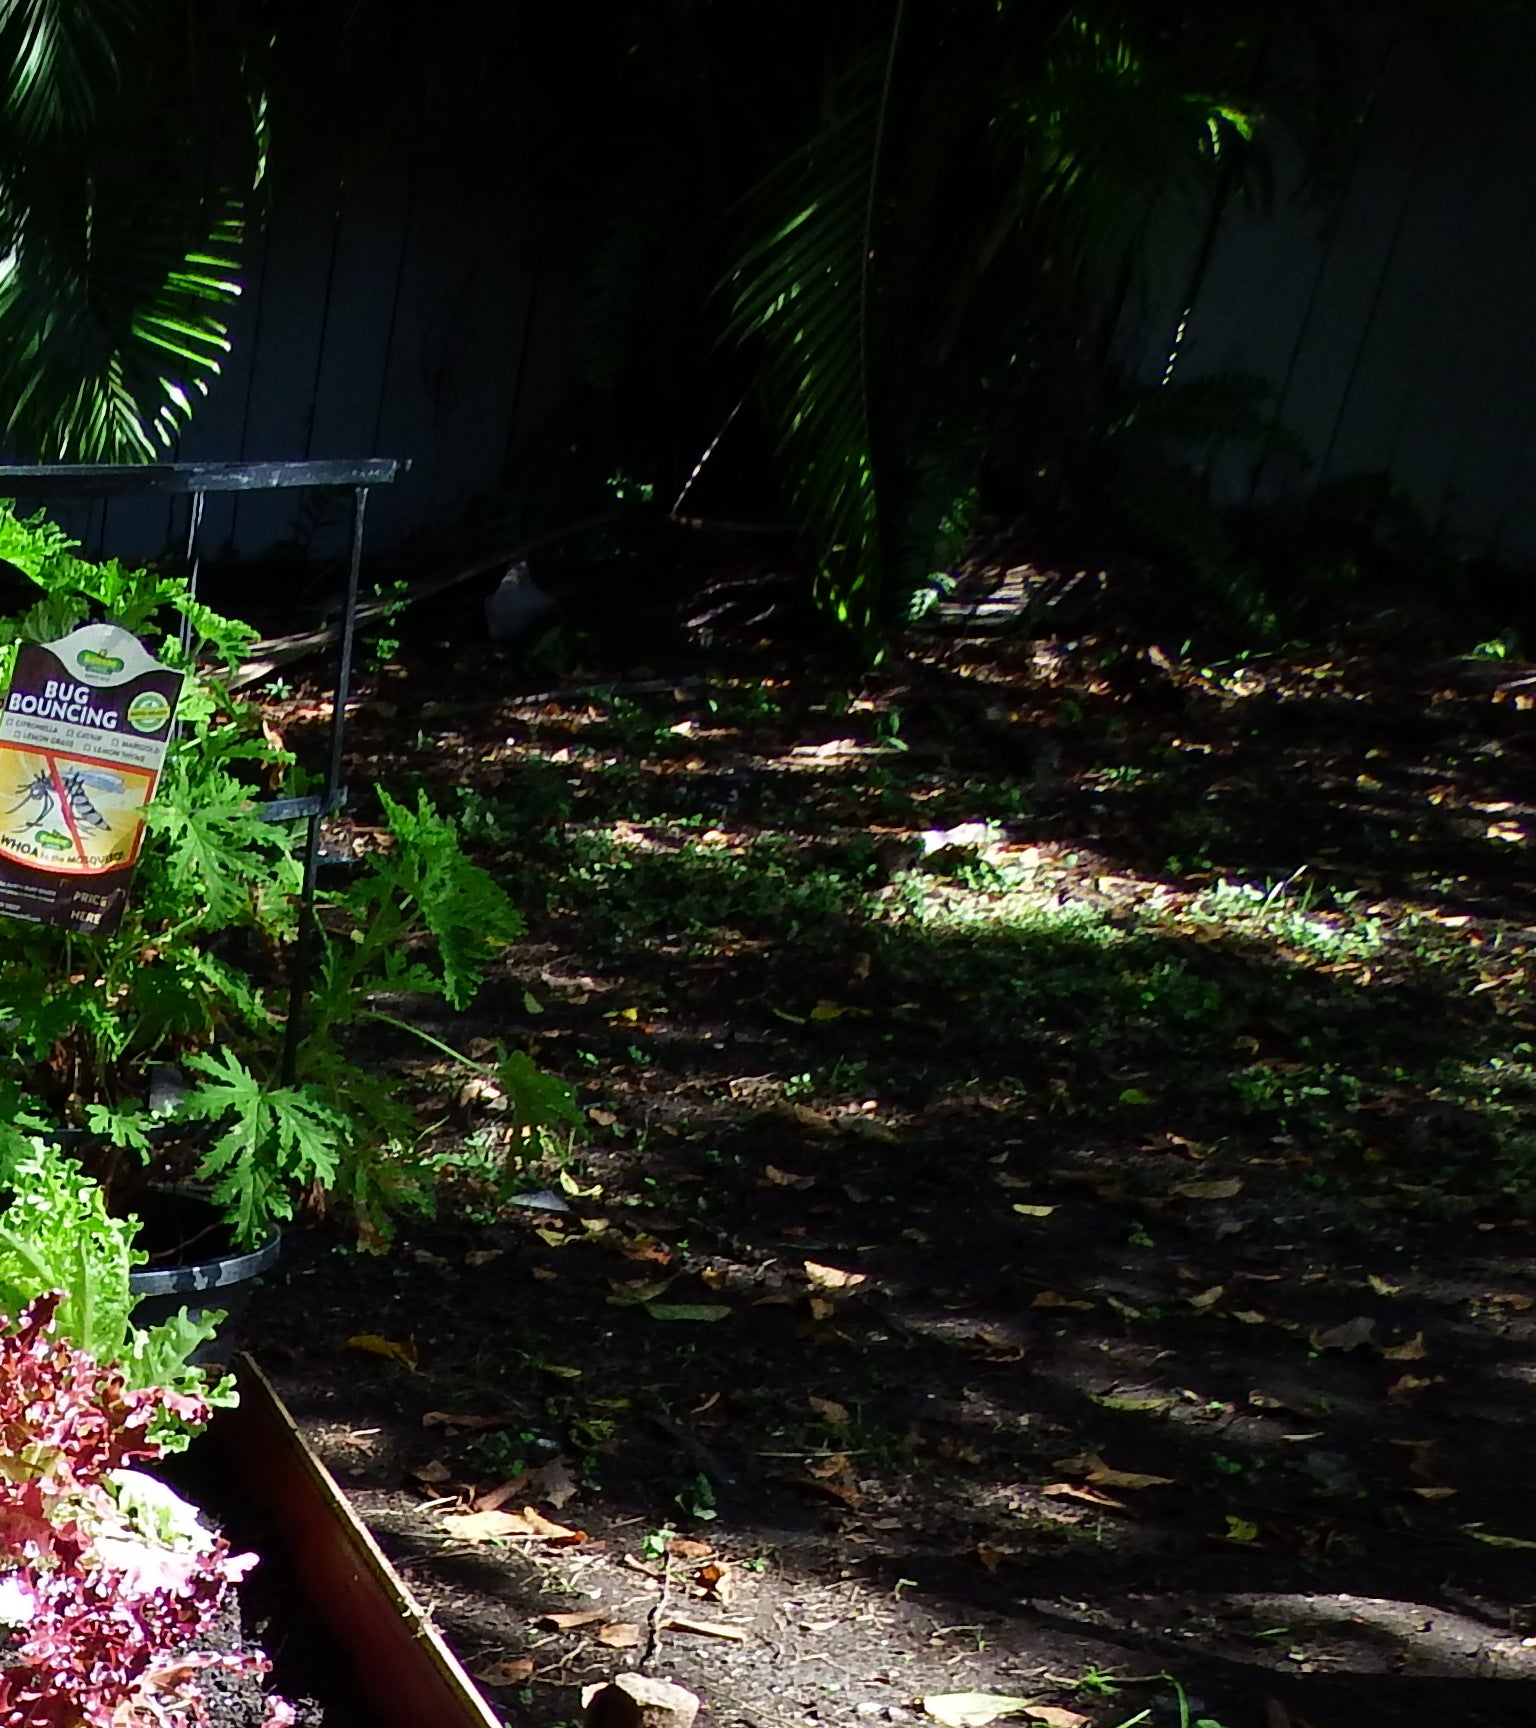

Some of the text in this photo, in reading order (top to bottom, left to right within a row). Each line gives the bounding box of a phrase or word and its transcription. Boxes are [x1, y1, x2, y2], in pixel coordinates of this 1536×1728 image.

[44, 680, 90, 704] BUG
[8, 692, 119, 729] BOUNCING
[16, 719, 58, 734] CITRONELLA
[22, 732, 49, 744] LEMON
[93, 745, 121, 757] LEMON
[1, 834, 38, 858] WHOA
[73, 890, 108, 907] PRICE
[70, 909, 103, 925] HERE
